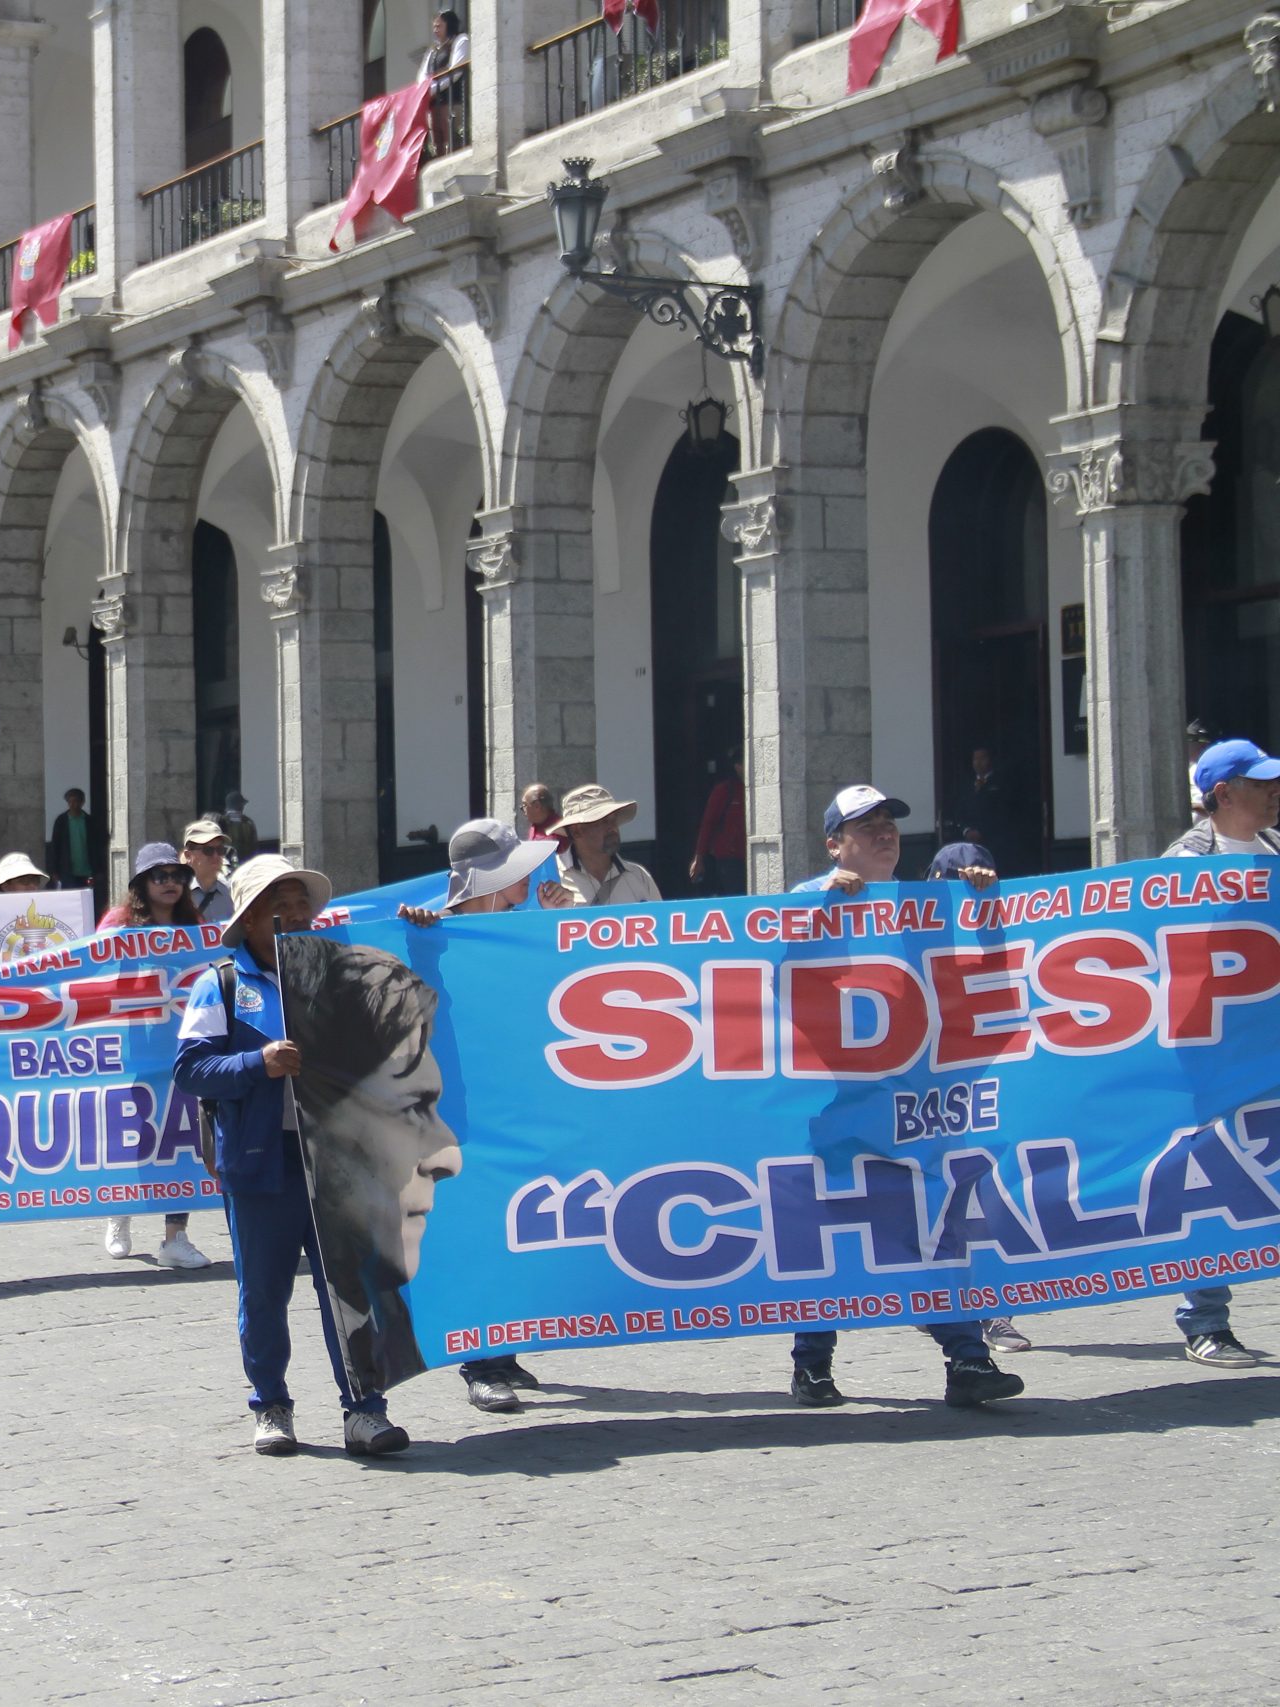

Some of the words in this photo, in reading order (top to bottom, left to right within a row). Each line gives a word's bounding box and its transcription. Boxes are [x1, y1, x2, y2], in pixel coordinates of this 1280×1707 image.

[559, 916, 657, 951] POR
[671, 912, 733, 944] LA
[746, 898, 945, 942] CENTRAL
[957, 886, 1072, 931] UNICA
[1081, 877, 1132, 915] DE
[1141, 869, 1270, 907] CLASE
[89, 928, 195, 963] UNICA
[200, 924, 228, 950] D
[544, 920, 1280, 1089] SIDESP
[9, 1034, 123, 1081] BASE
[894, 1079, 999, 1145] BASE
[17, 1190, 45, 1208] DE
[50, 1187, 91, 1206] LOS
[96, 1180, 195, 1203] CENTROS
[445, 1328, 481, 1354] EN
[487, 1313, 618, 1346] DEFENSA
[625, 1310, 665, 1334] DE
[672, 1305, 732, 1332] LOS
[738, 1293, 903, 1326] DERECHOS
[910, 1289, 952, 1315] DE
[959, 1287, 1000, 1311] LOS
[1002, 1273, 1109, 1305] CENTROS
[1116, 1267, 1147, 1291] DE
[1150, 1244, 1280, 1286] EDUCACIO
